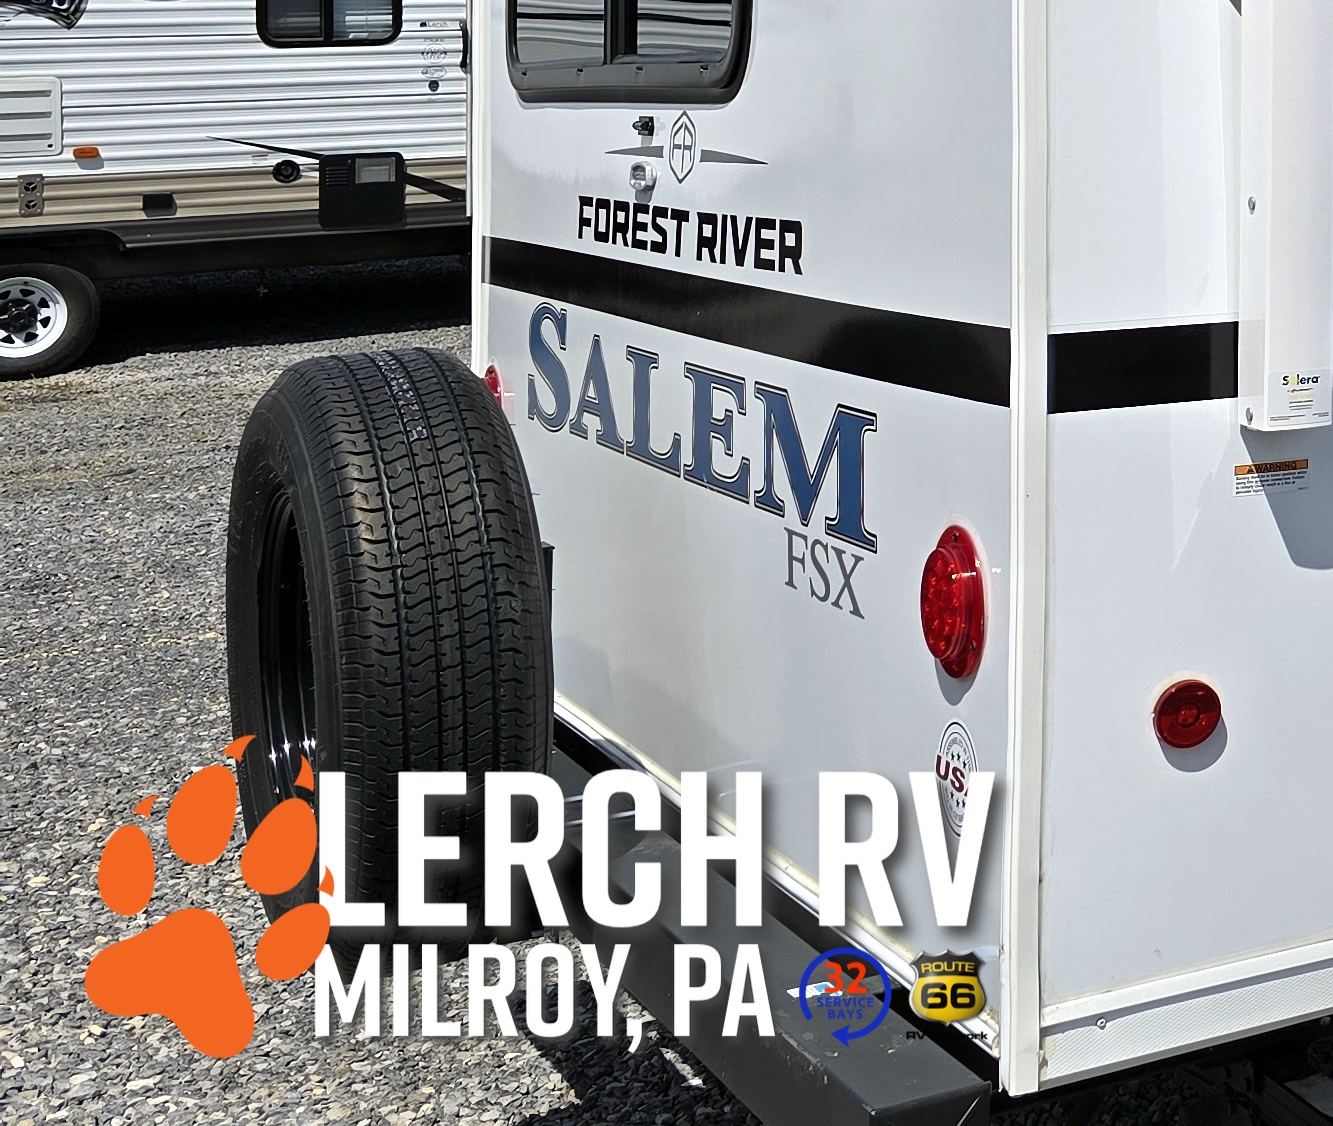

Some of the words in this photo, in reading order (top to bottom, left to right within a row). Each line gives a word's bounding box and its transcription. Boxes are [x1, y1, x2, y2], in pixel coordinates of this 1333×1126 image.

[578, 196, 690, 258] FOREST
[696, 211, 804, 275] RIVER
[528, 302, 877, 554] SALEM
[784, 526, 865, 620] FSX
[935, 754, 969, 797] US
